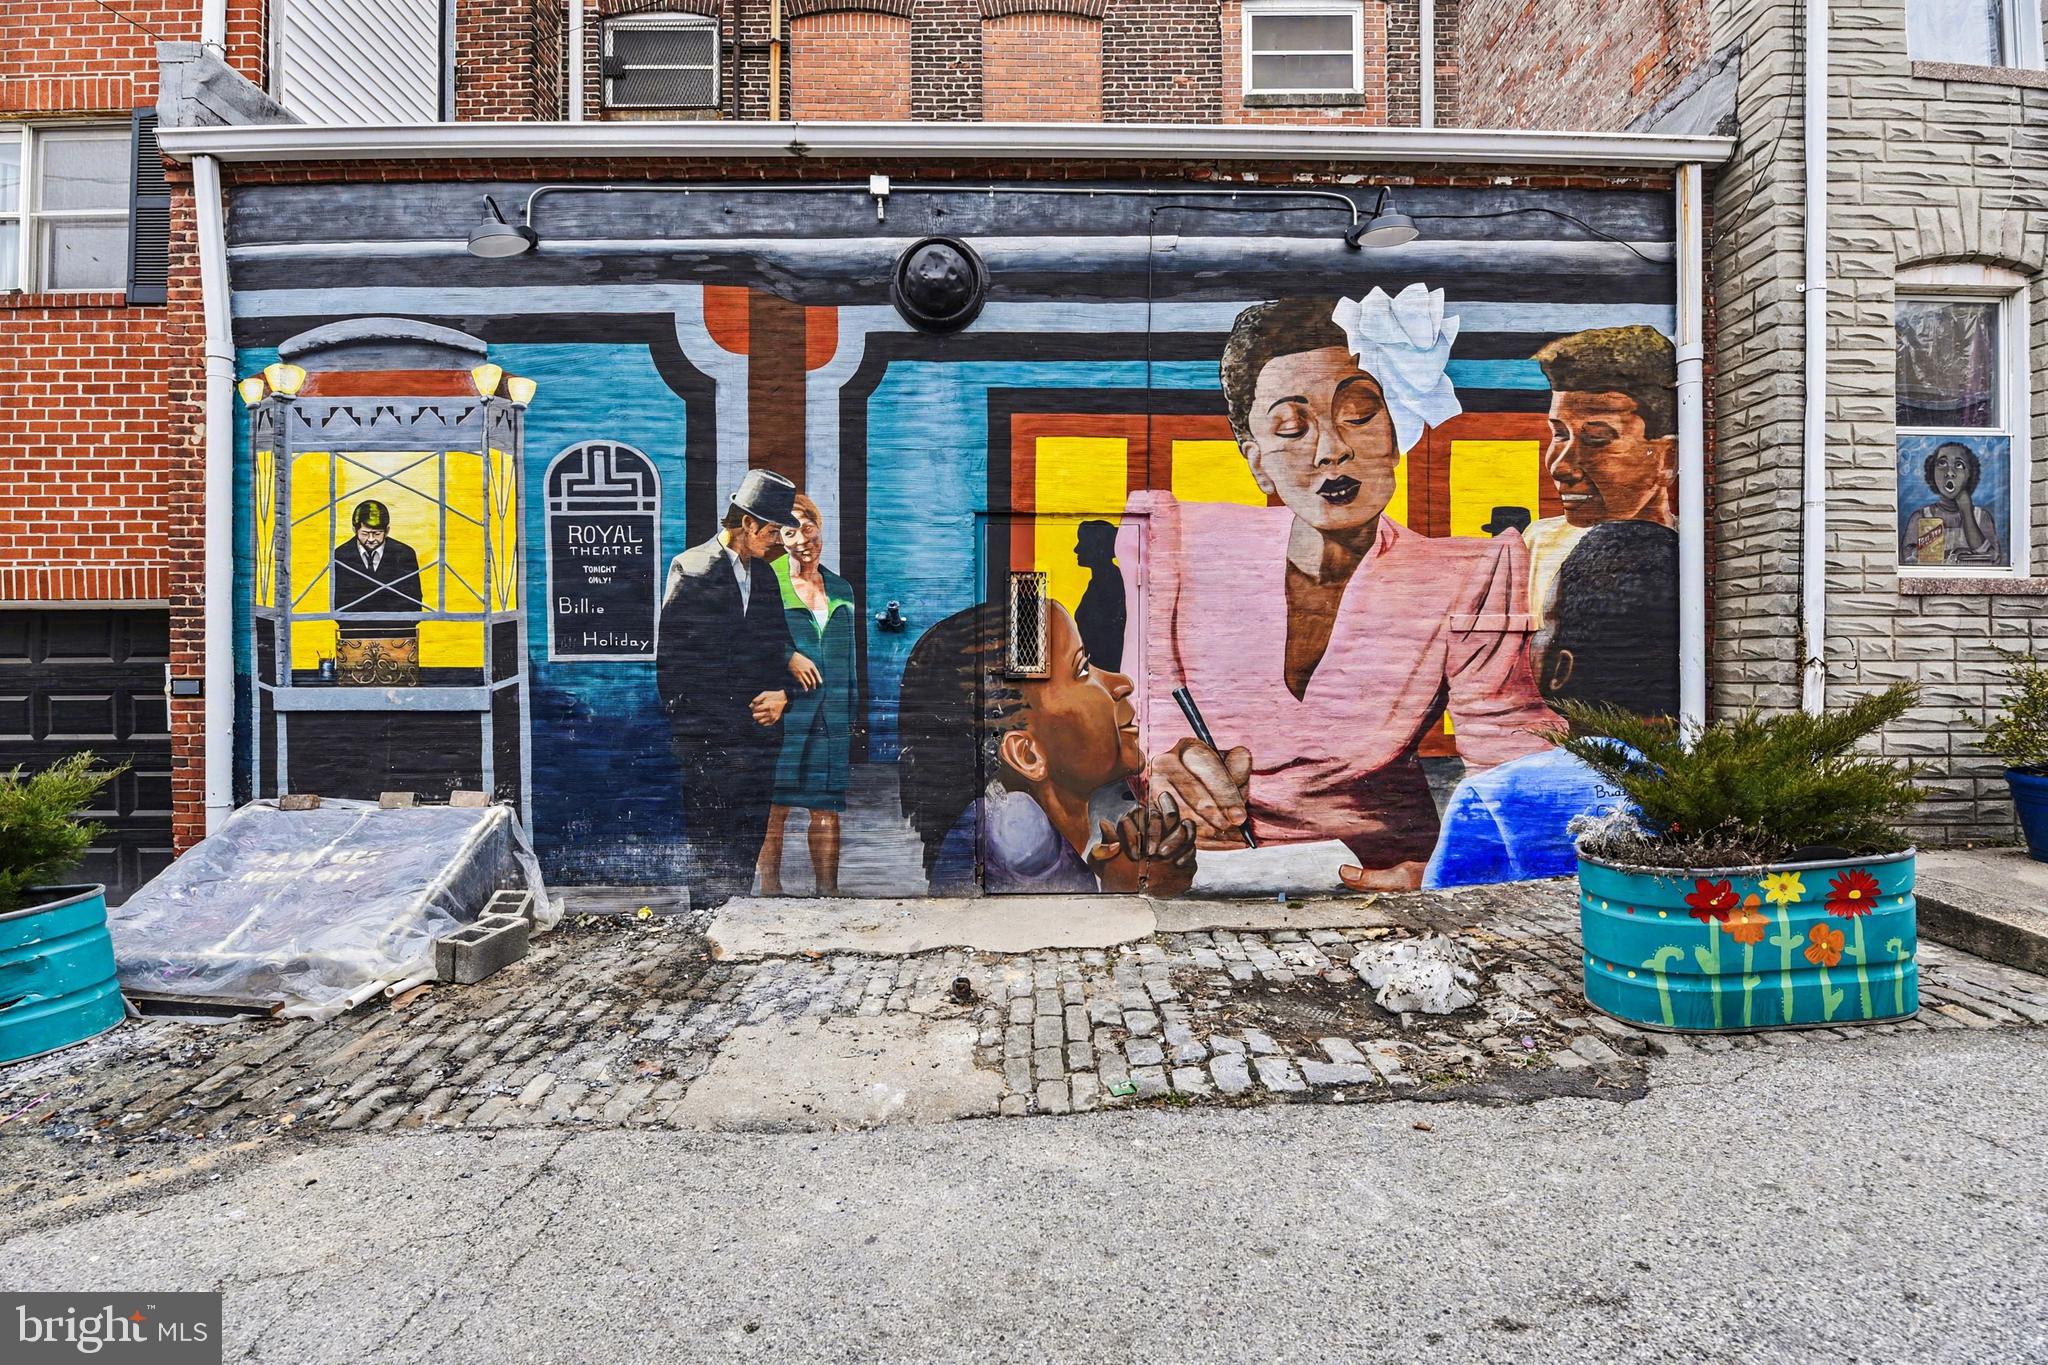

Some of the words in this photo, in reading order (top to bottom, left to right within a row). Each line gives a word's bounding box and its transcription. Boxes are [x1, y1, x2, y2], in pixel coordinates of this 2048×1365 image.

[568, 525, 643, 544] ROYAL
[569, 546, 643, 556] THEATRE
[588, 576, 612, 584] ONLY!
[559, 596, 605, 614] Billie
[583, 631, 649, 650] Holiday
